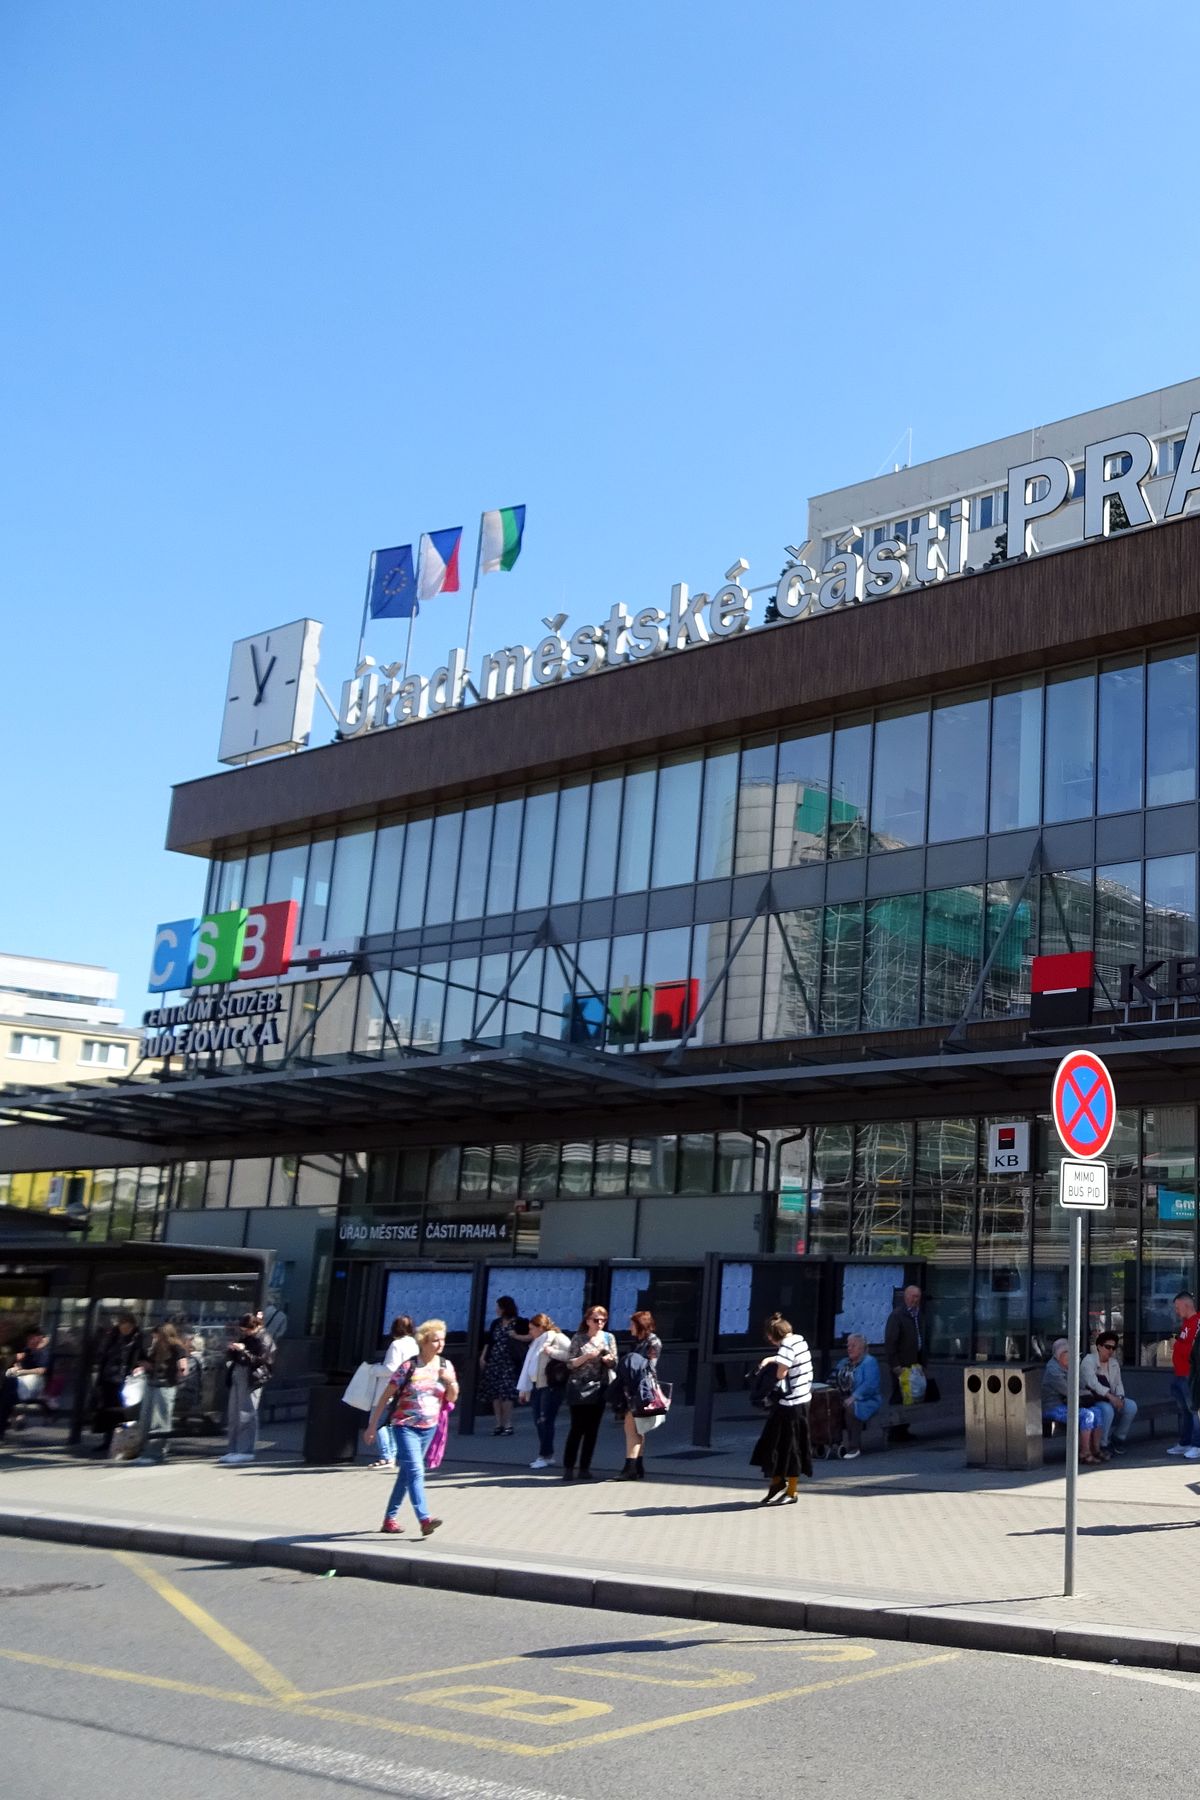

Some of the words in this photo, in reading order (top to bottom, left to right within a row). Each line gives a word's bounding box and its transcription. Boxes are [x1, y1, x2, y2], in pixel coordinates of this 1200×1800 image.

[338, 647, 466, 736] Úřad
[480, 558, 752, 700] městské
[776, 498, 971, 619] části
[150, 912, 267, 986] CSB
[994, 1154, 1019, 1168] KB
[1074, 1170, 1095, 1183] MIMO
[1068, 1185, 1085, 1197] BUS
[1087, 1186, 1101, 1198] PID
[339, 1223, 368, 1240] ÚŘAD
[370, 1223, 418, 1240] MĚSTSKÉ
[425, 1222, 457, 1239] ČÁSTI
[459, 1223, 496, 1239] PRAHA
[499, 1225, 507, 1238] 4
